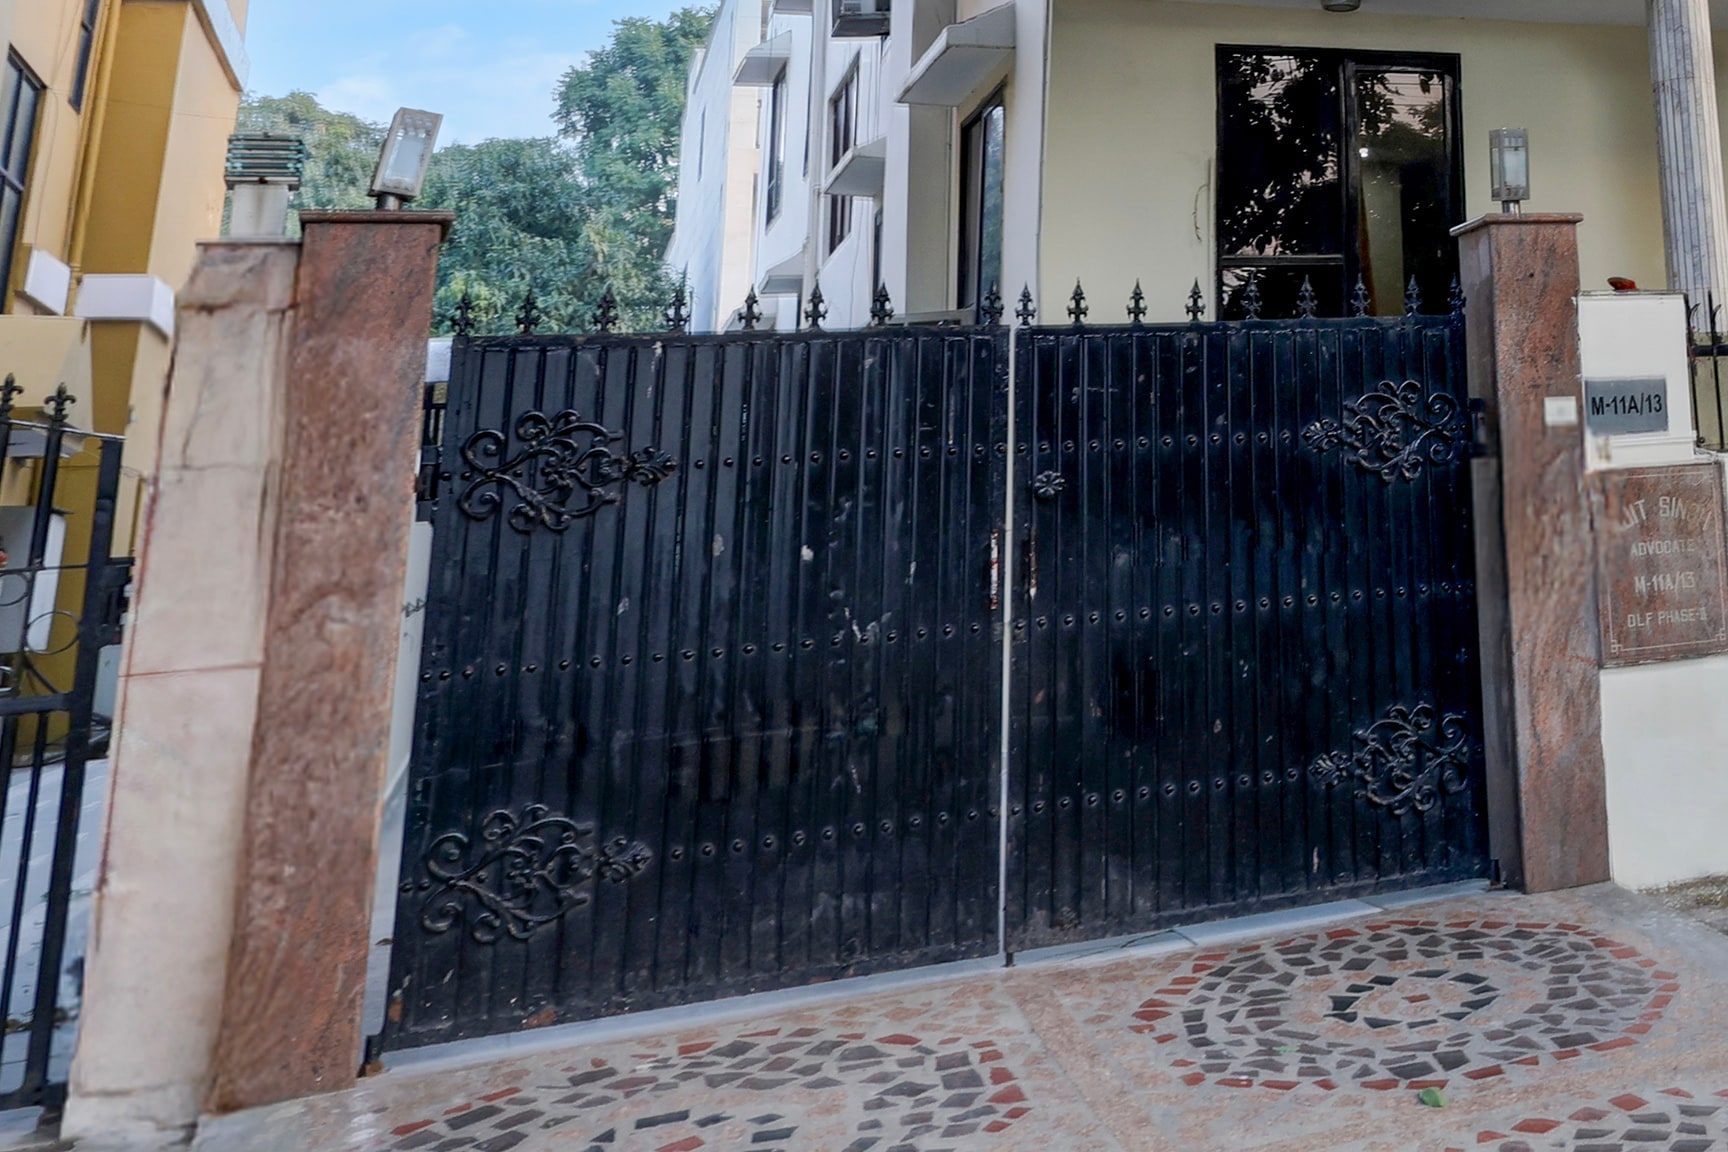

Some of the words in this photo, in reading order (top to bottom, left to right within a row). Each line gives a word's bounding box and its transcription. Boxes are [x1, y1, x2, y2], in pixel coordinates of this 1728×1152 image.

[1591, 393, 1663, 415] M-11A/13
[1630, 539, 1695, 557] ADVOCATE
[1634, 571, 1696, 595] M-11A/13
[1627, 612, 1653, 628] DLF
